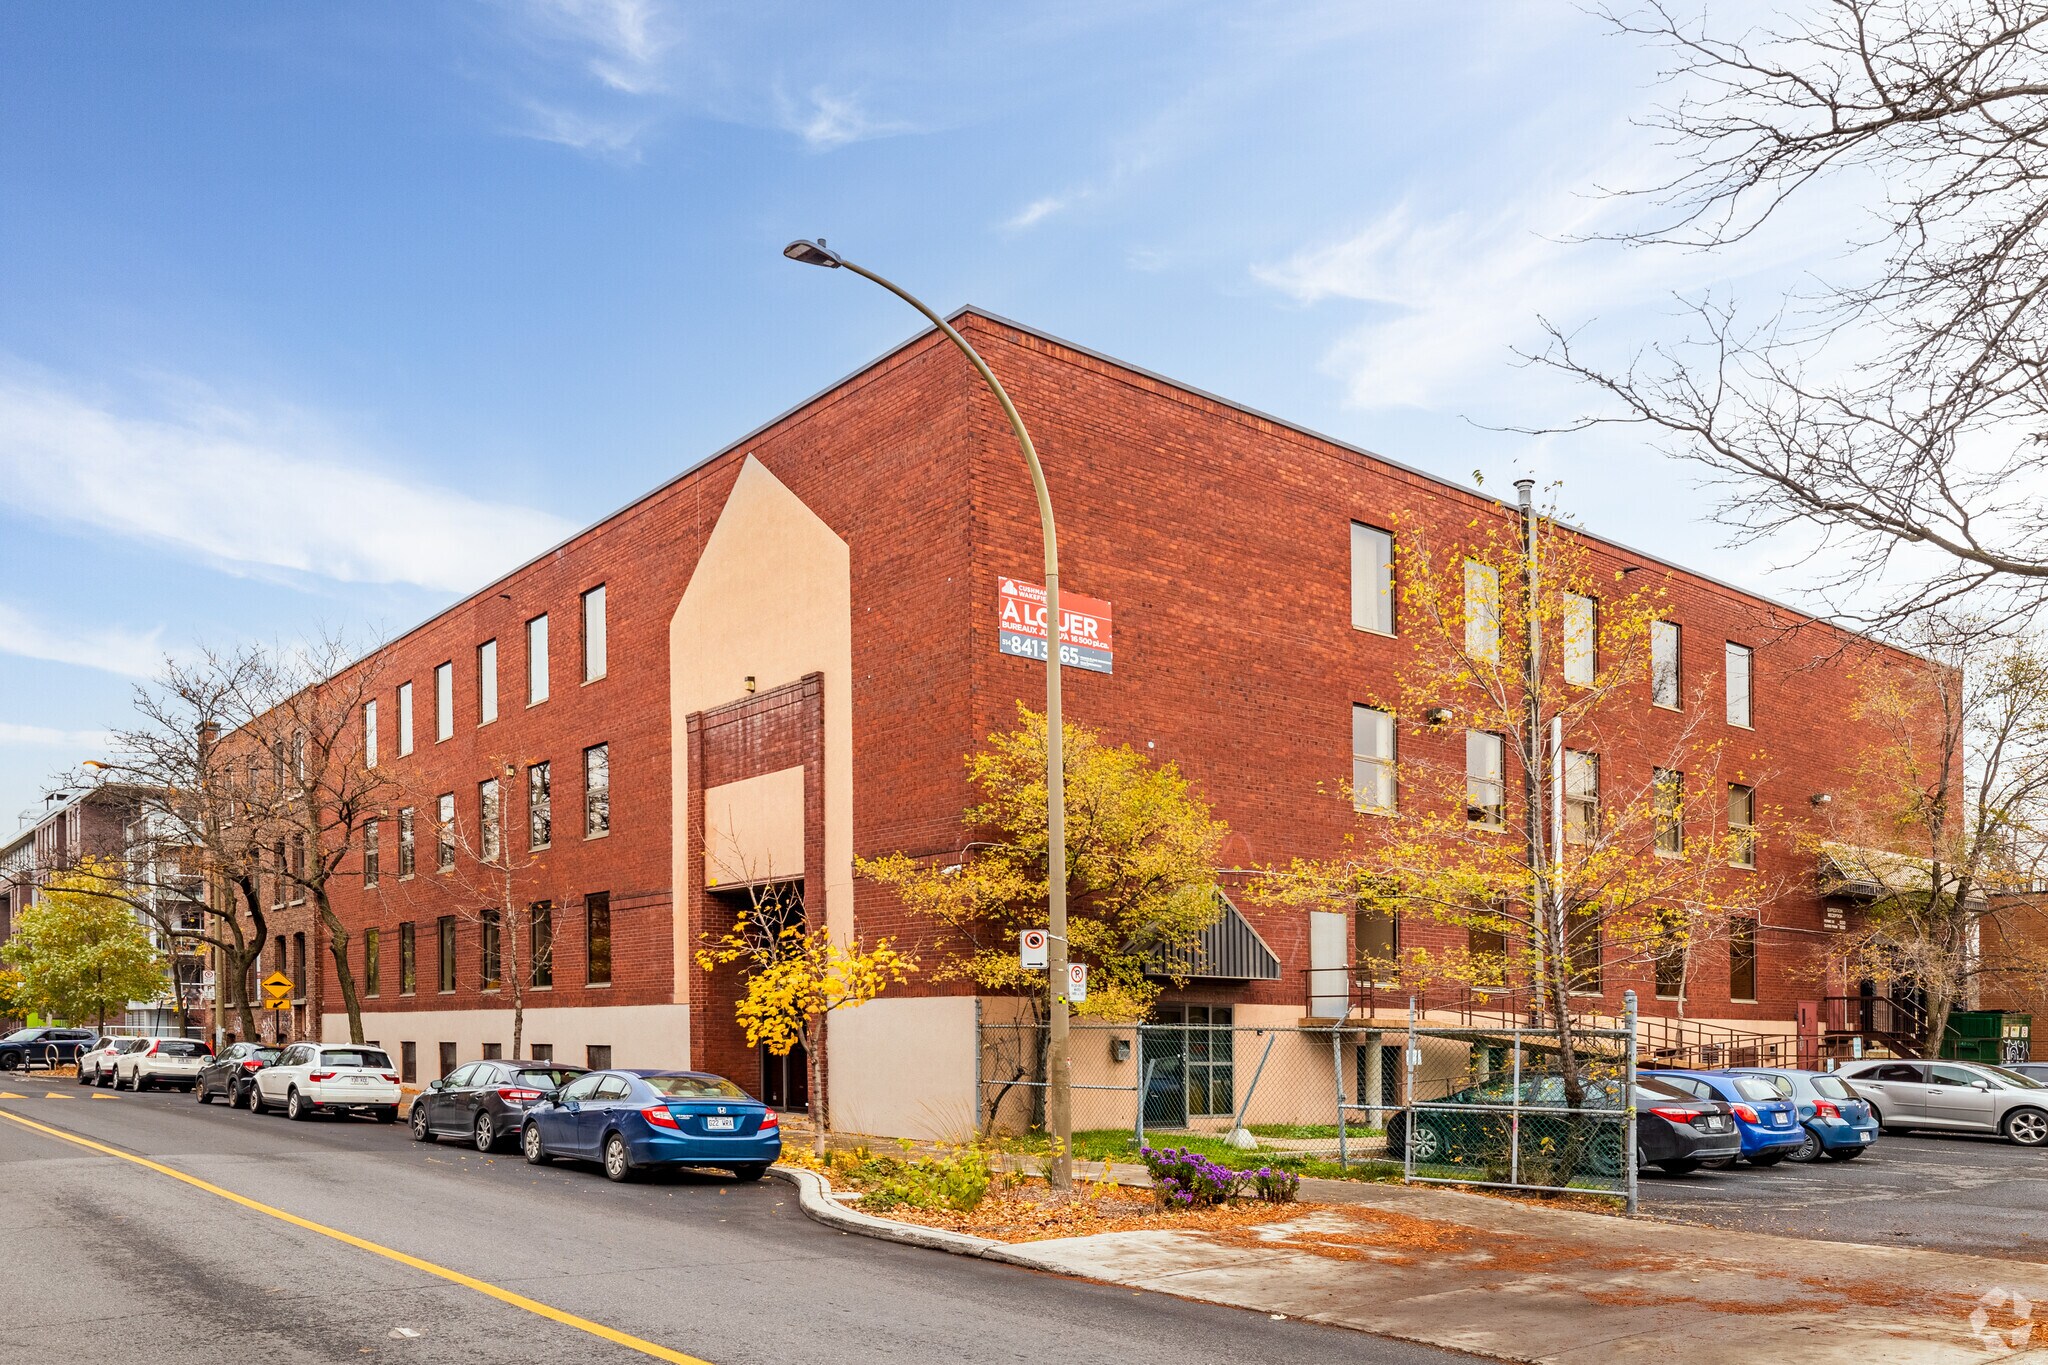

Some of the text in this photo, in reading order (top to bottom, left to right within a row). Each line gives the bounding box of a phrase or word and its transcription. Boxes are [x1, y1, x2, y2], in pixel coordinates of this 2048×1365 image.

[1001, 620, 1038, 634] BUREAUX
[1024, 604, 1098, 639] LOUER
[1011, 636, 1038, 657] 841
[1040, 641, 1079, 665] 365
